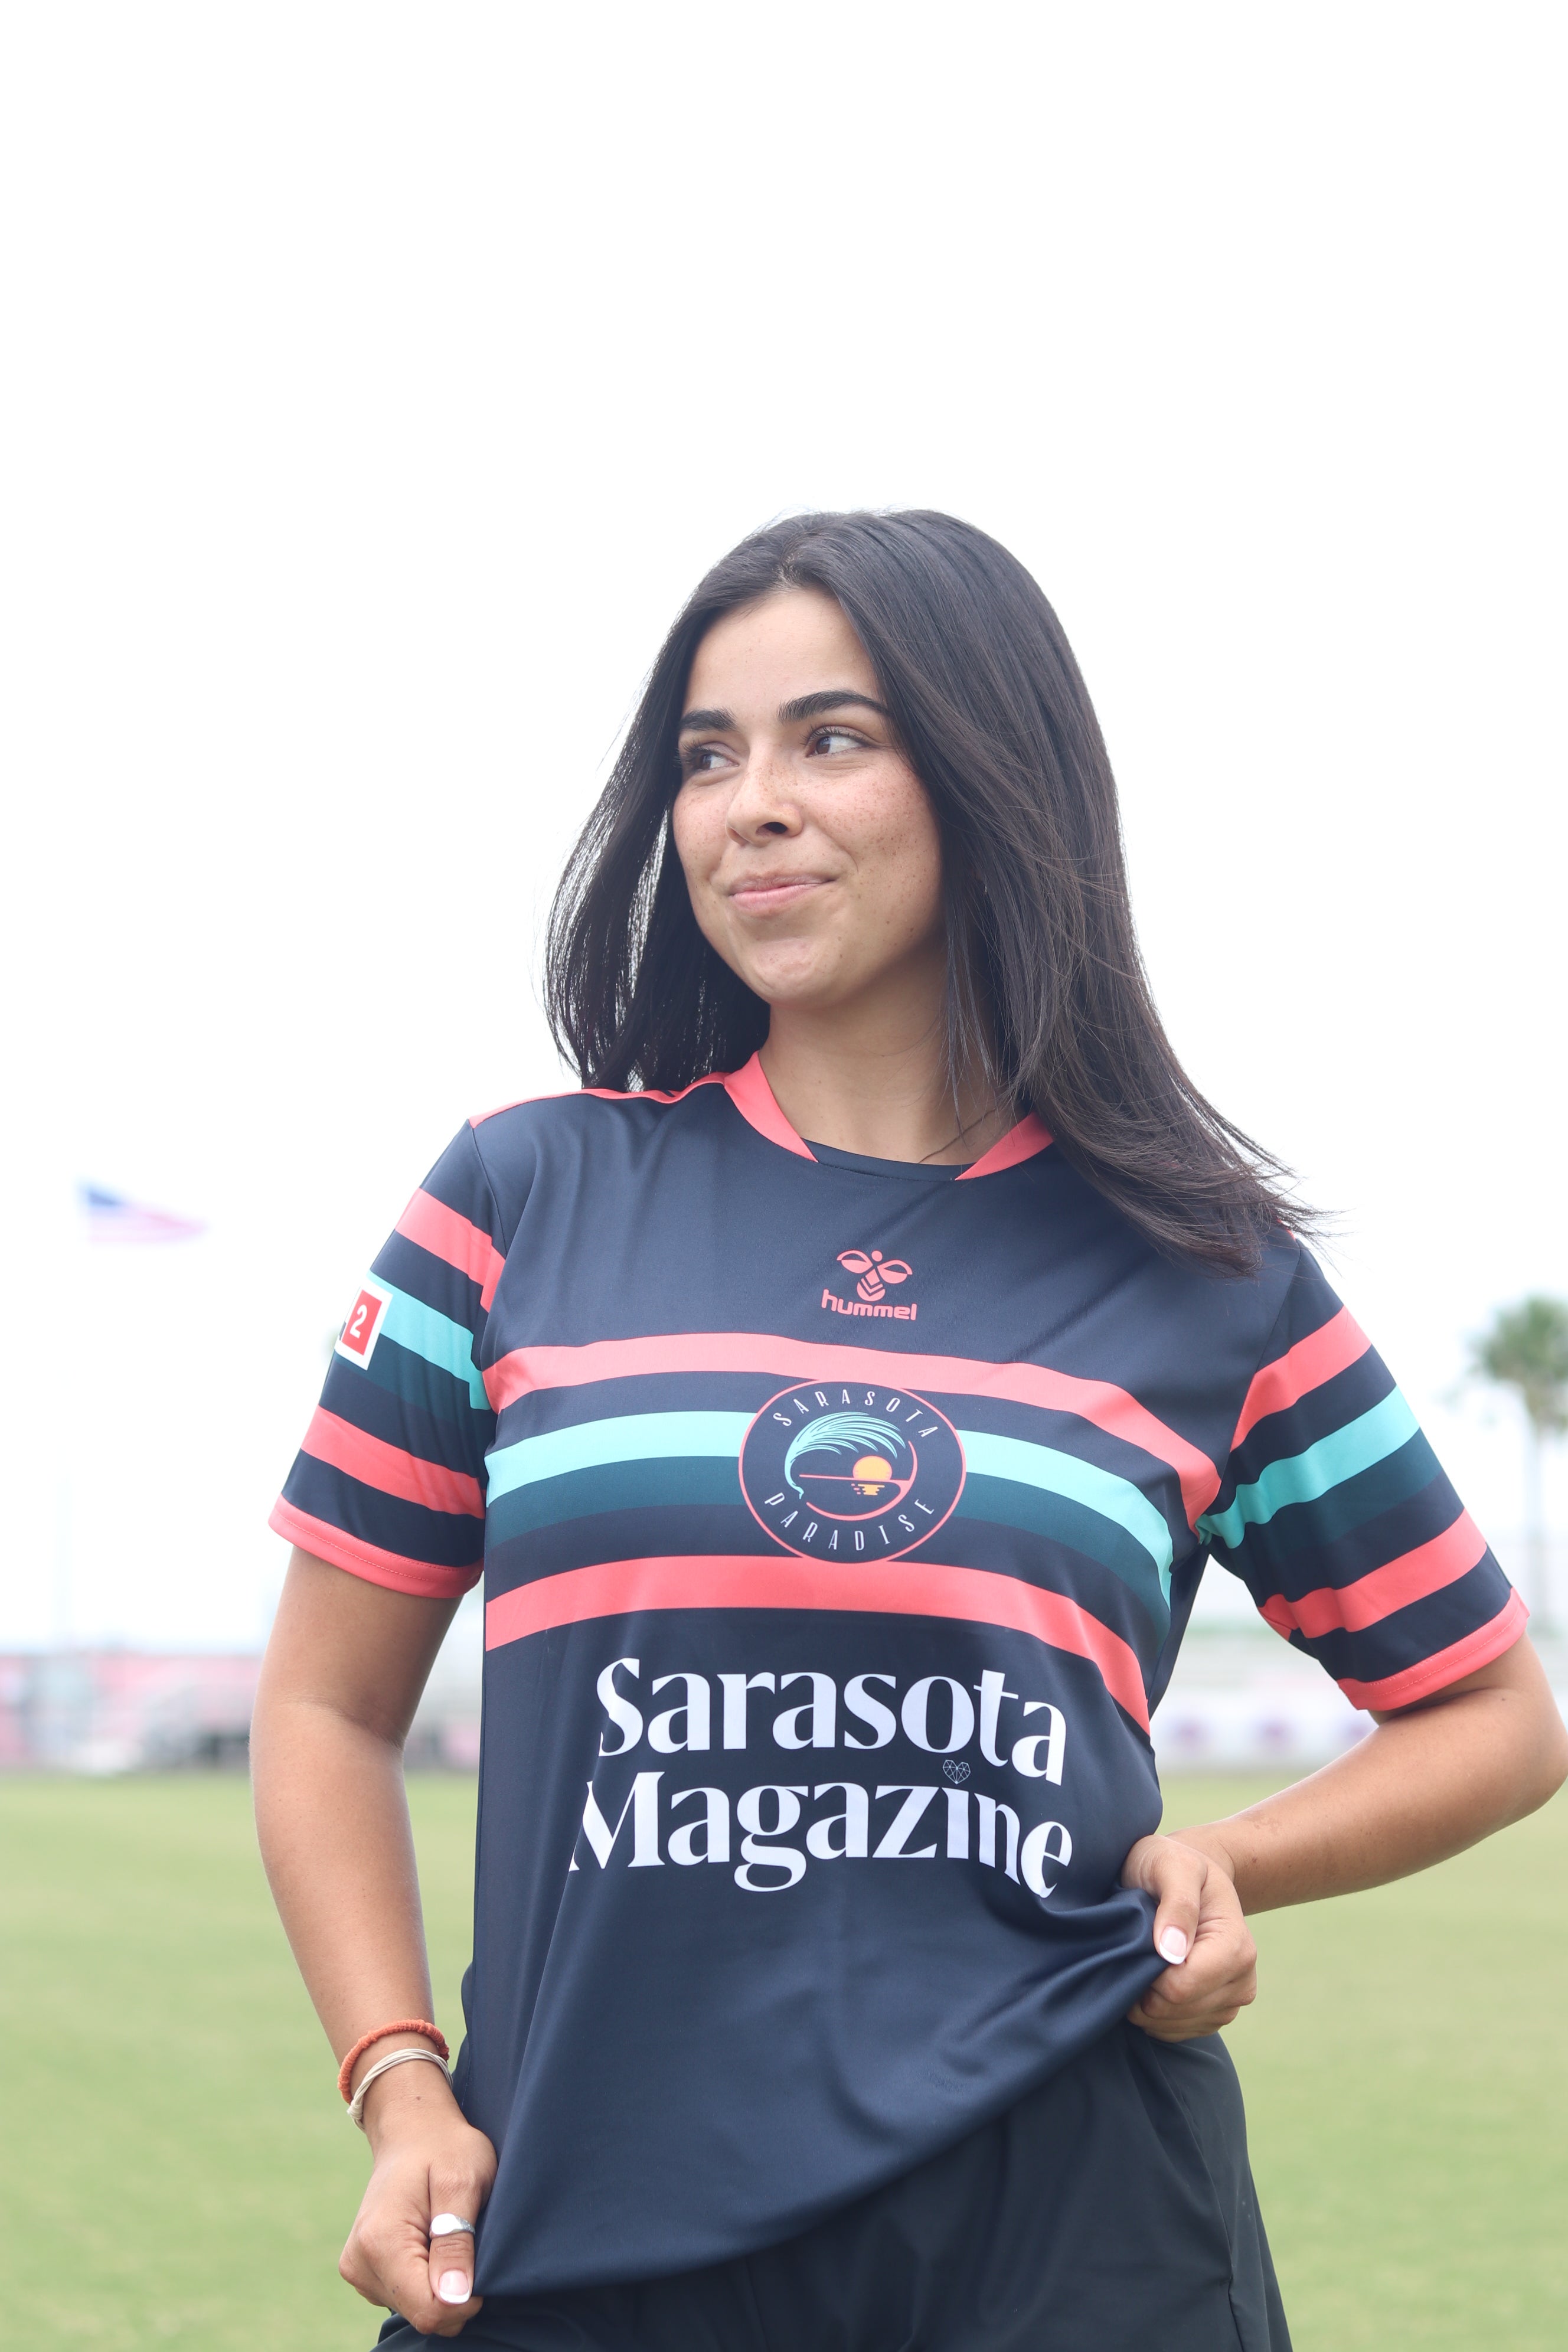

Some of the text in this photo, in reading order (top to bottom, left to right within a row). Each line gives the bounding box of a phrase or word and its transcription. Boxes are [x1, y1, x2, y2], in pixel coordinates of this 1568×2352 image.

[349, 1304, 368, 1339] 2
[821, 1289, 917, 1321] hummel
[772, 1389, 938, 1438] SARASOTA
[764, 1492, 935, 1551] PARADISE
[596, 1657, 1066, 1786] Sarasota
[568, 1771, 1073, 1899] Magazine
